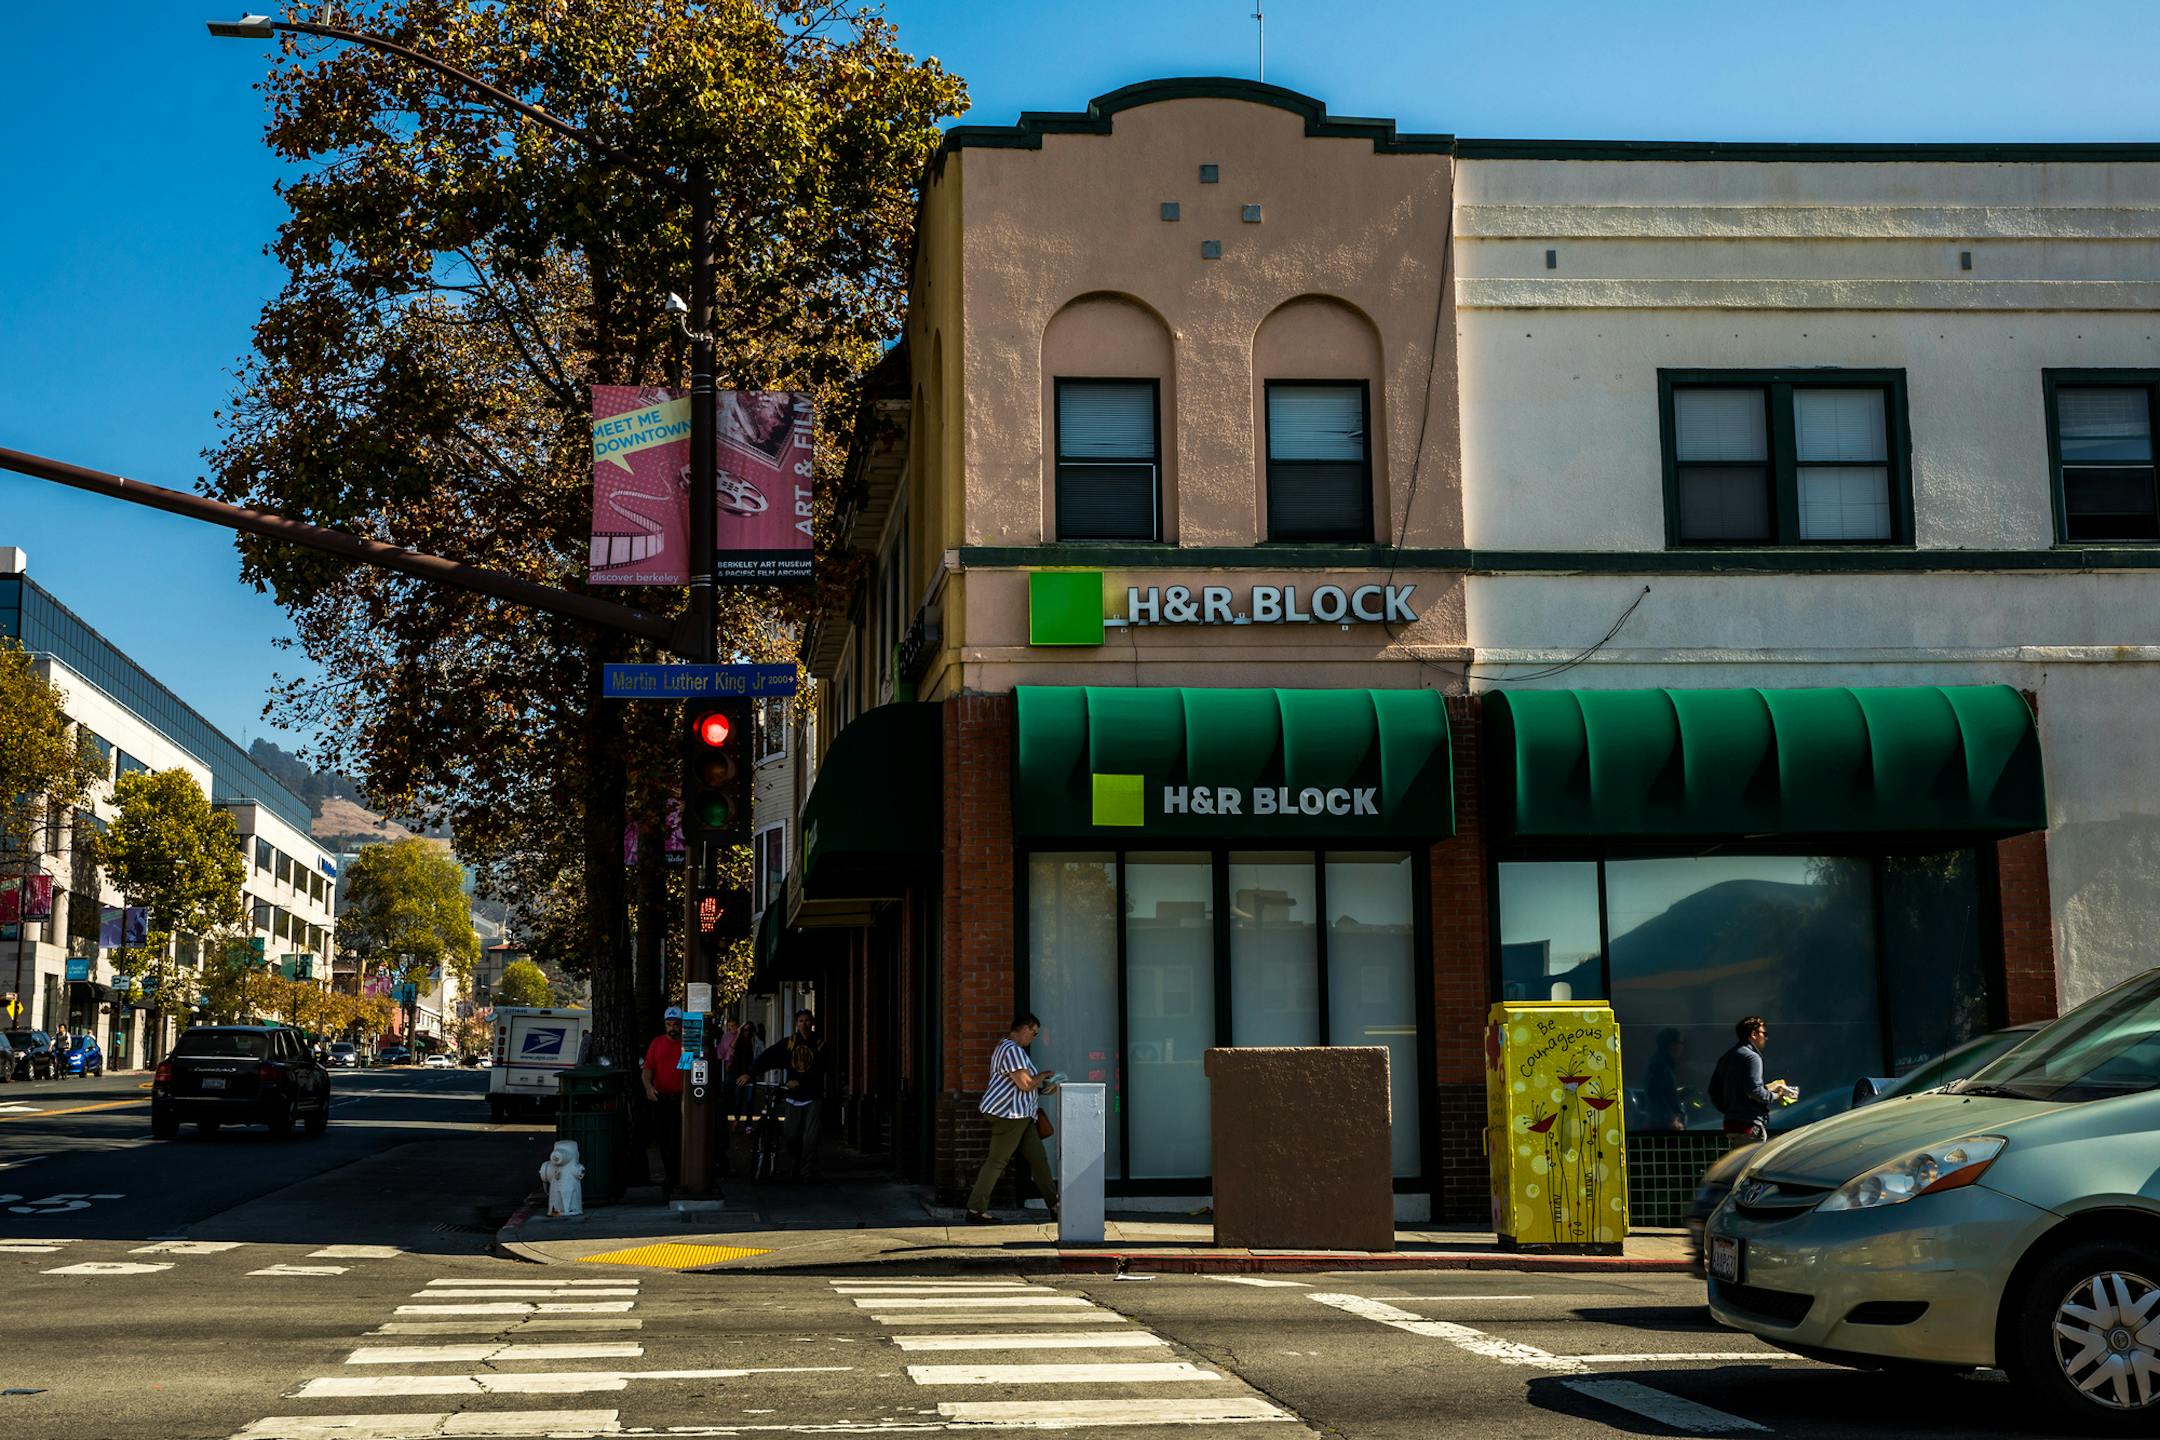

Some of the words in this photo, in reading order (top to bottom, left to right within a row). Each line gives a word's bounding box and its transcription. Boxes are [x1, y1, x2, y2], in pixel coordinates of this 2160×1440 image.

[592, 417, 633, 439] MEET
[637, 410, 662, 427] ME
[793, 391, 813, 450] FILM
[595, 419, 692, 455] DOWNTOWN
[793, 459, 813, 478] &
[794, 484, 814, 537] ART
[591, 572, 633, 582] discover
[636, 571, 679, 584] berkeley
[717, 561, 758, 569] BERKELEY
[778, 560, 812, 568] MUSEUM
[725, 569, 755, 577] PACIFIC
[1127, 585, 1234, 624] H&R
[1250, 584, 1420, 623] BLOCK
[611, 671, 657, 690] Martin
[663, 672, 709, 690] Luther
[714, 672, 746, 694] King
[751, 673, 766, 690] Jr
[767, 676, 789, 685] 2000
[1163, 786, 1243, 816] H&R
[1253, 787, 1379, 816] BLOCK
[1536, 1019, 1556, 1036] Be
